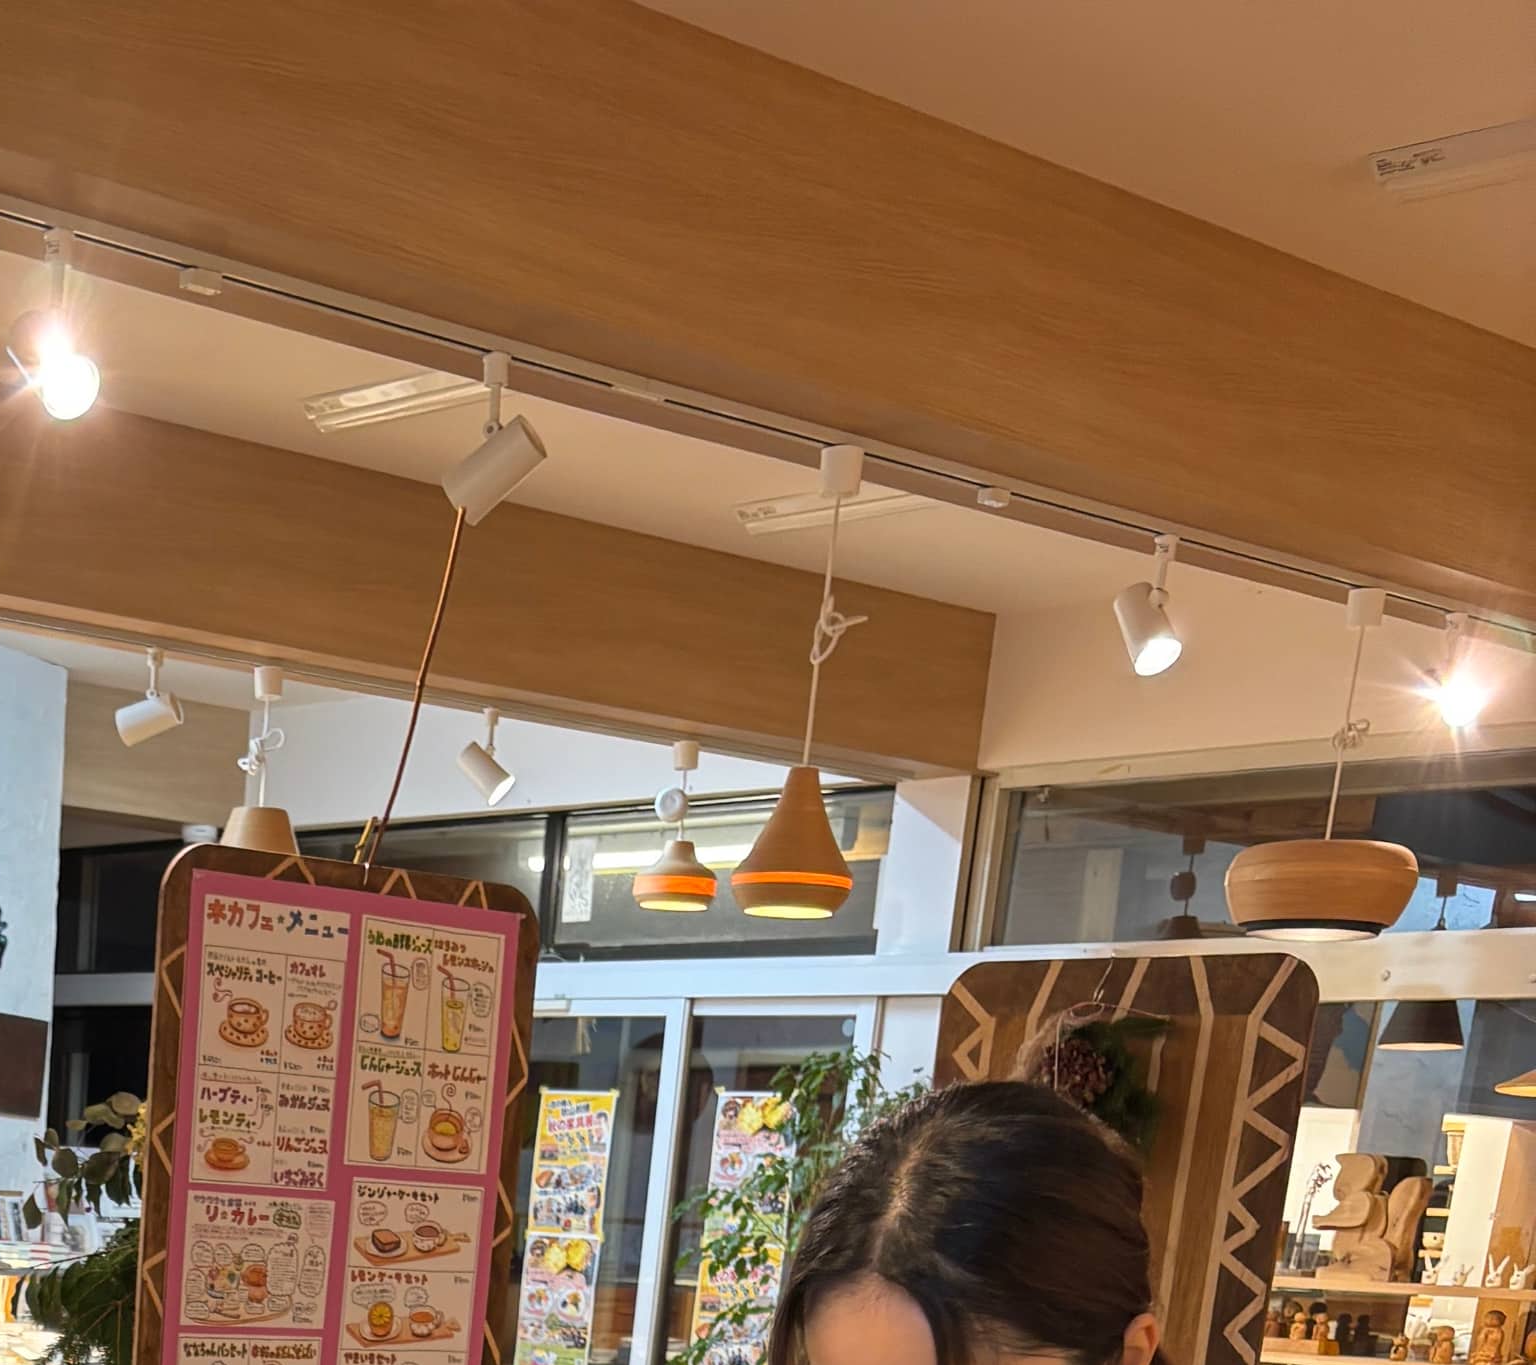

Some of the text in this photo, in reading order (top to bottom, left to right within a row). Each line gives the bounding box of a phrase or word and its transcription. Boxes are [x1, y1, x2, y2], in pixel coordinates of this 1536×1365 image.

[286, 911, 348, 938] メニュー
[200, 1087, 254, 1104] ハーブティー
[198, 1108, 257, 1128] レモンティー
